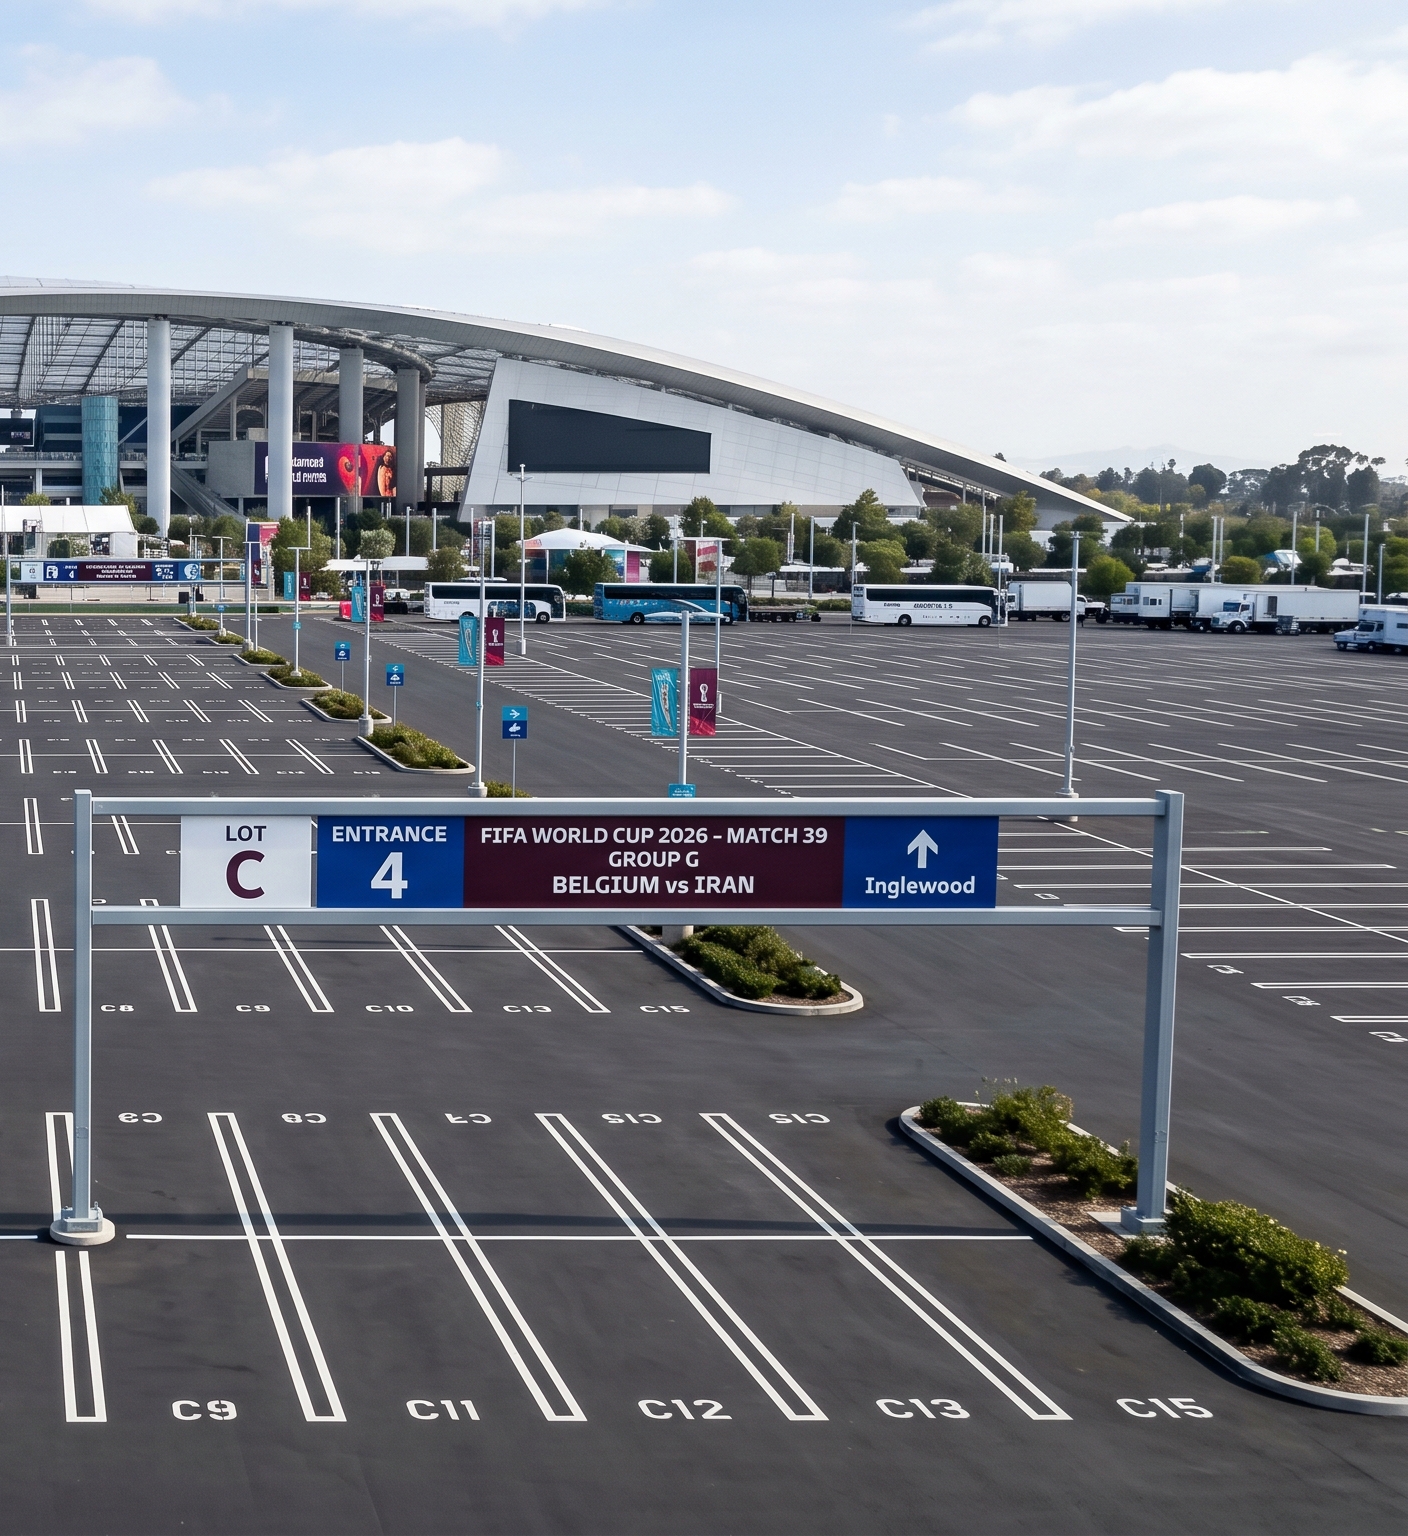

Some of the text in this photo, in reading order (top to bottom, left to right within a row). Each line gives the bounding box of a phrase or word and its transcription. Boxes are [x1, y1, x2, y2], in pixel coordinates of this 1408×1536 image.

[225, 825, 267, 842] LOT
[332, 825, 447, 842] ENTRANCE
[481, 827, 528, 844] FIFA
[531, 827, 608, 844] WORLD
[613, 827, 654, 844] CUP
[658, 827, 708, 844] 2026
[727, 827, 798, 844] MATCH
[802, 827, 828, 844] 39
[608, 851, 699, 868] GROUP G
[225, 850, 265, 900] C
[370, 851, 408, 899] 4
[553, 875, 754, 894] BELGIUM vs IRAN
[865, 875, 975, 899] Inglewood
[235, 1004, 271, 1012] C9
[365, 1004, 414, 1013] C10
[502, 1005, 552, 1013] C13
[639, 1005, 690, 1013] C15
[171, 1399, 238, 1421] C9
[405, 1399, 481, 1421] C11
[637, 1399, 733, 1420] C12
[875, 1398, 971, 1419] C13
[1116, 1397, 1214, 1419] C15
